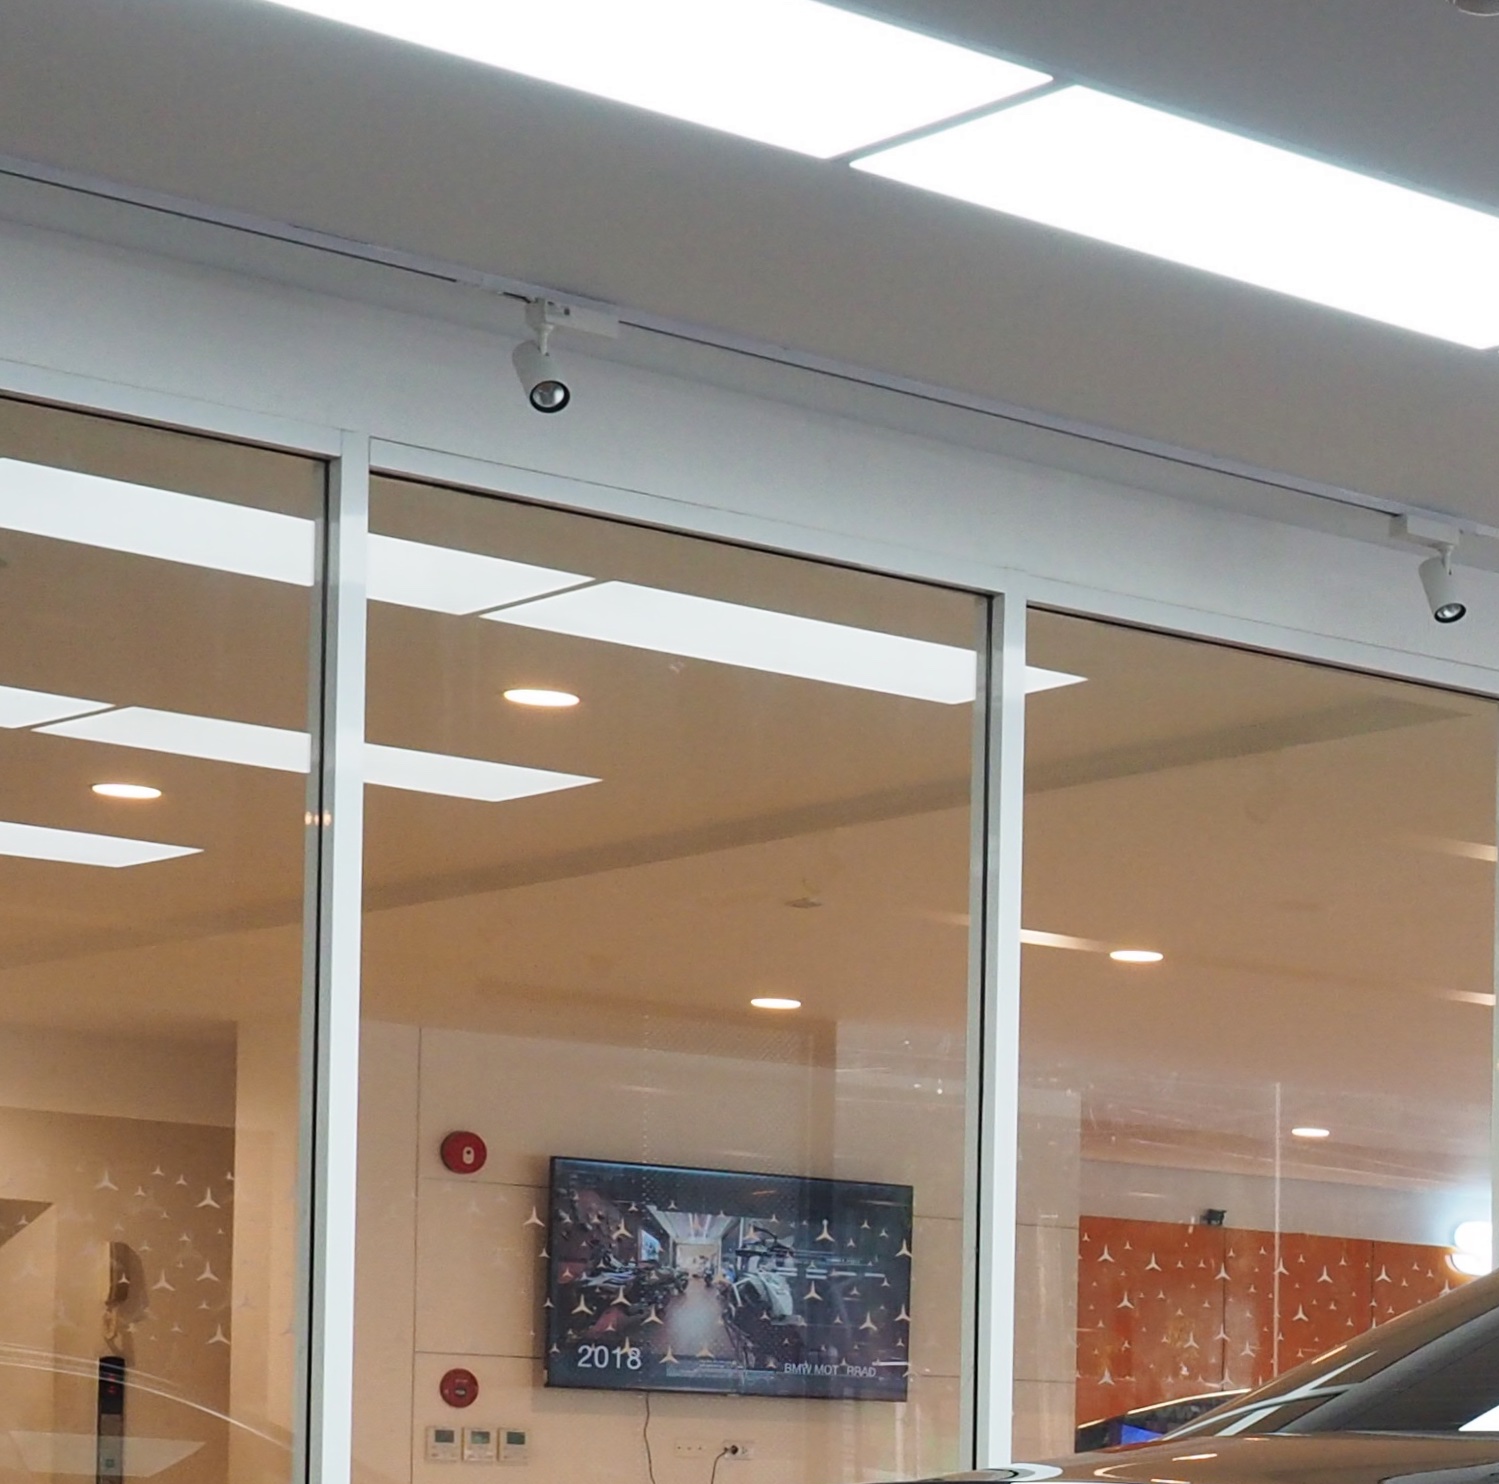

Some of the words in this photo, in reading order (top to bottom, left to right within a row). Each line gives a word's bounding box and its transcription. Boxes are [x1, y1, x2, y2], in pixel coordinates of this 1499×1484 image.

[577, 1345, 642, 1370] 2018
[784, 1362, 812, 1375] BMW
[814, 1363, 877, 1378] MOTRRAD
